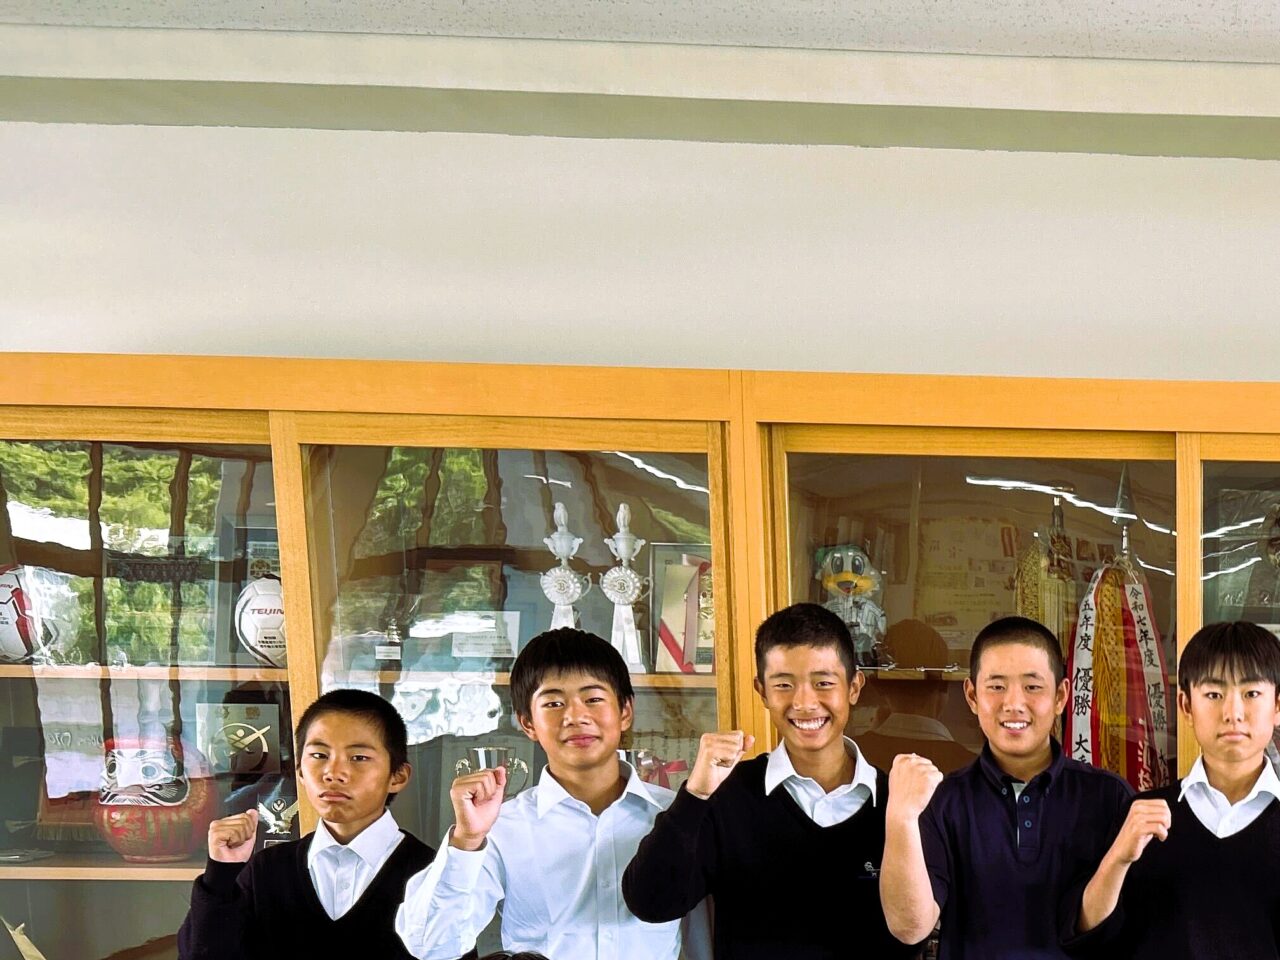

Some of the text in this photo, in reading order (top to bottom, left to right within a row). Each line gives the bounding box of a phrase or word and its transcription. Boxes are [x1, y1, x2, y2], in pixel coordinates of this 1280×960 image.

[250, 608, 285, 616] TEIJIN
[1128, 585, 1159, 668] 令和七年度
[1147, 680, 1169, 731] 優勝
[1072, 667, 1093, 717] 優勝
